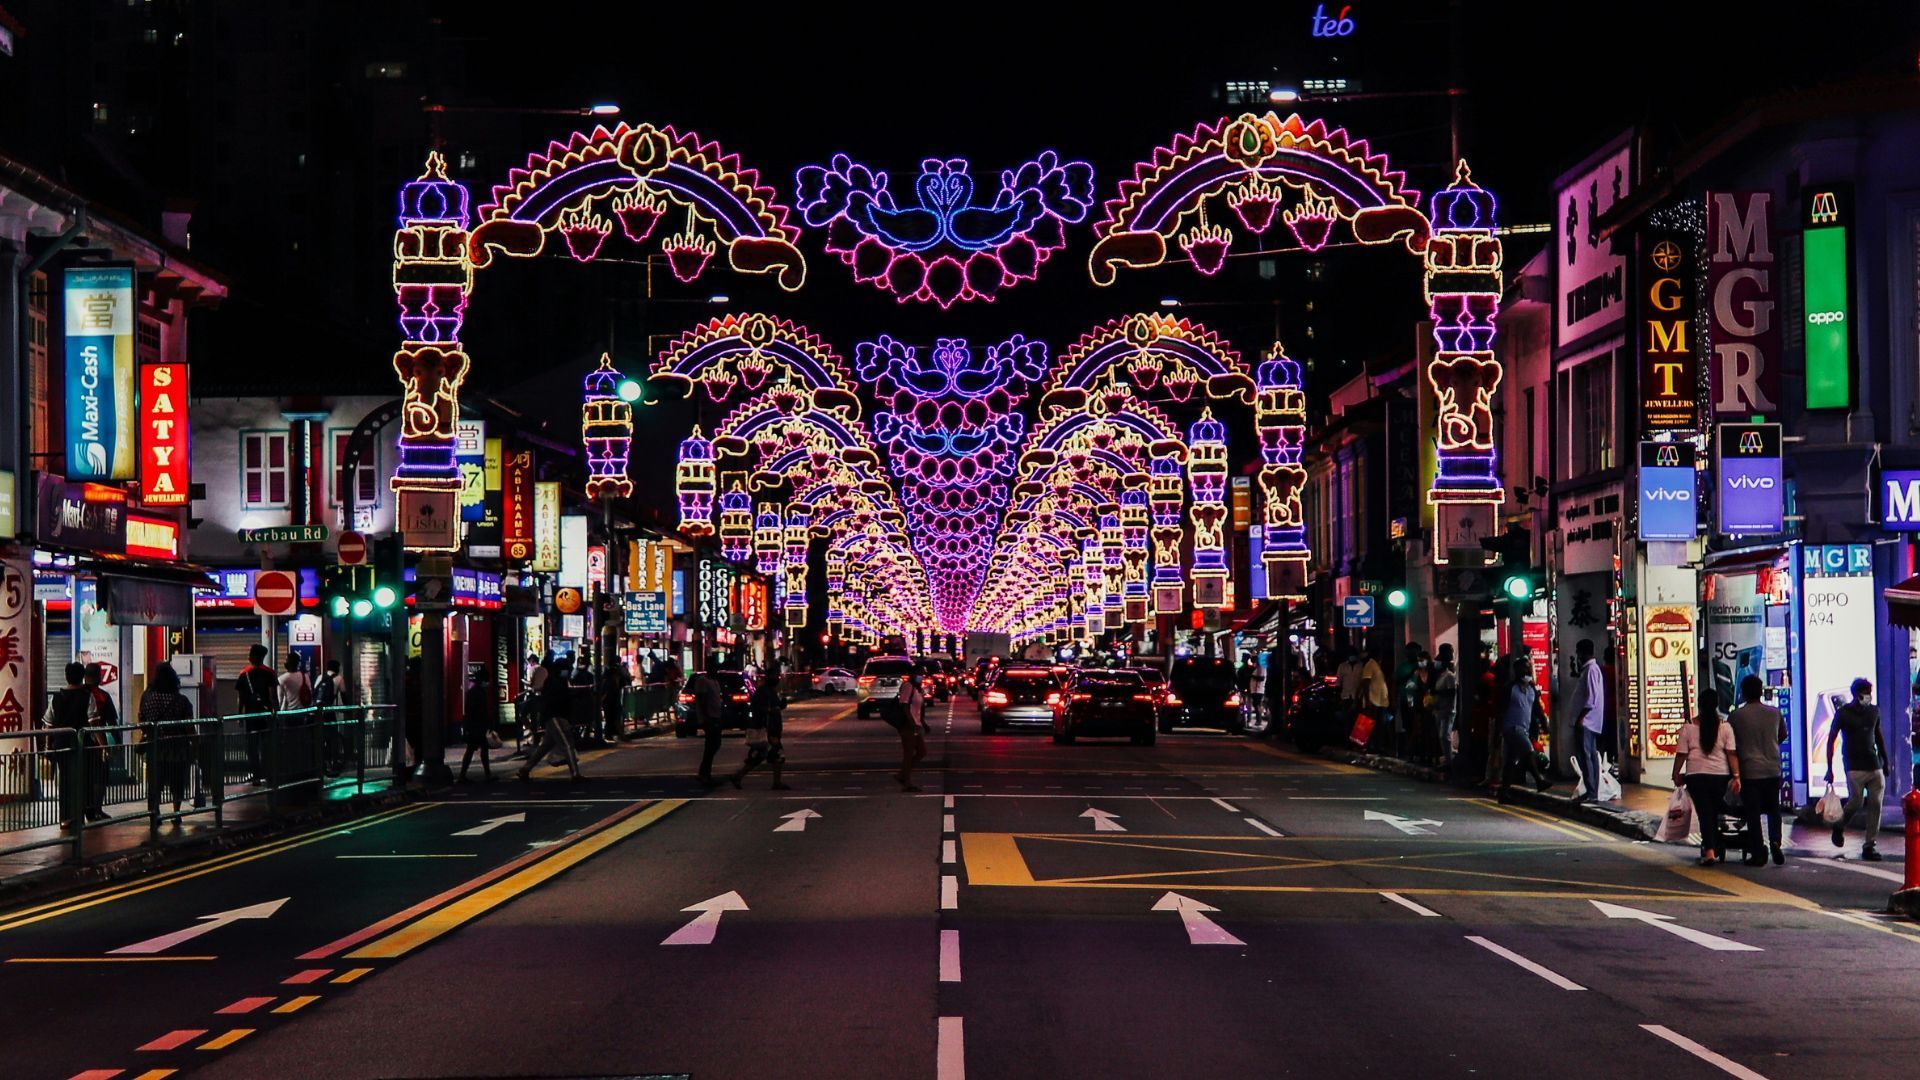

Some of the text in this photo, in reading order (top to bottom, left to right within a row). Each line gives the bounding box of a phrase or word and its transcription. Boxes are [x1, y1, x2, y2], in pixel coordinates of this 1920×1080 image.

[1713, 192, 1777, 412] MGR
[1808, 311, 1844, 325] oppo
[80, 345, 99, 441] Maxi-Cash
[1645, 400, 1694, 408] JEWELLERS
[151, 367, 175, 493] SATYA
[1727, 474, 1775, 489] vivo
[143, 494, 186, 503] JEWELLERY
[1645, 487, 1691, 501] vivo
[244, 528, 322, 542] Kerbau Rd
[513, 547, 524, 556] 85
[627, 600, 664, 611] Bus Lane
[1808, 592, 1849, 608] OPPO
[1709, 604, 1741, 614] realme
[1809, 612, 1834, 626] A94
[1714, 642, 1738, 660] 5G
